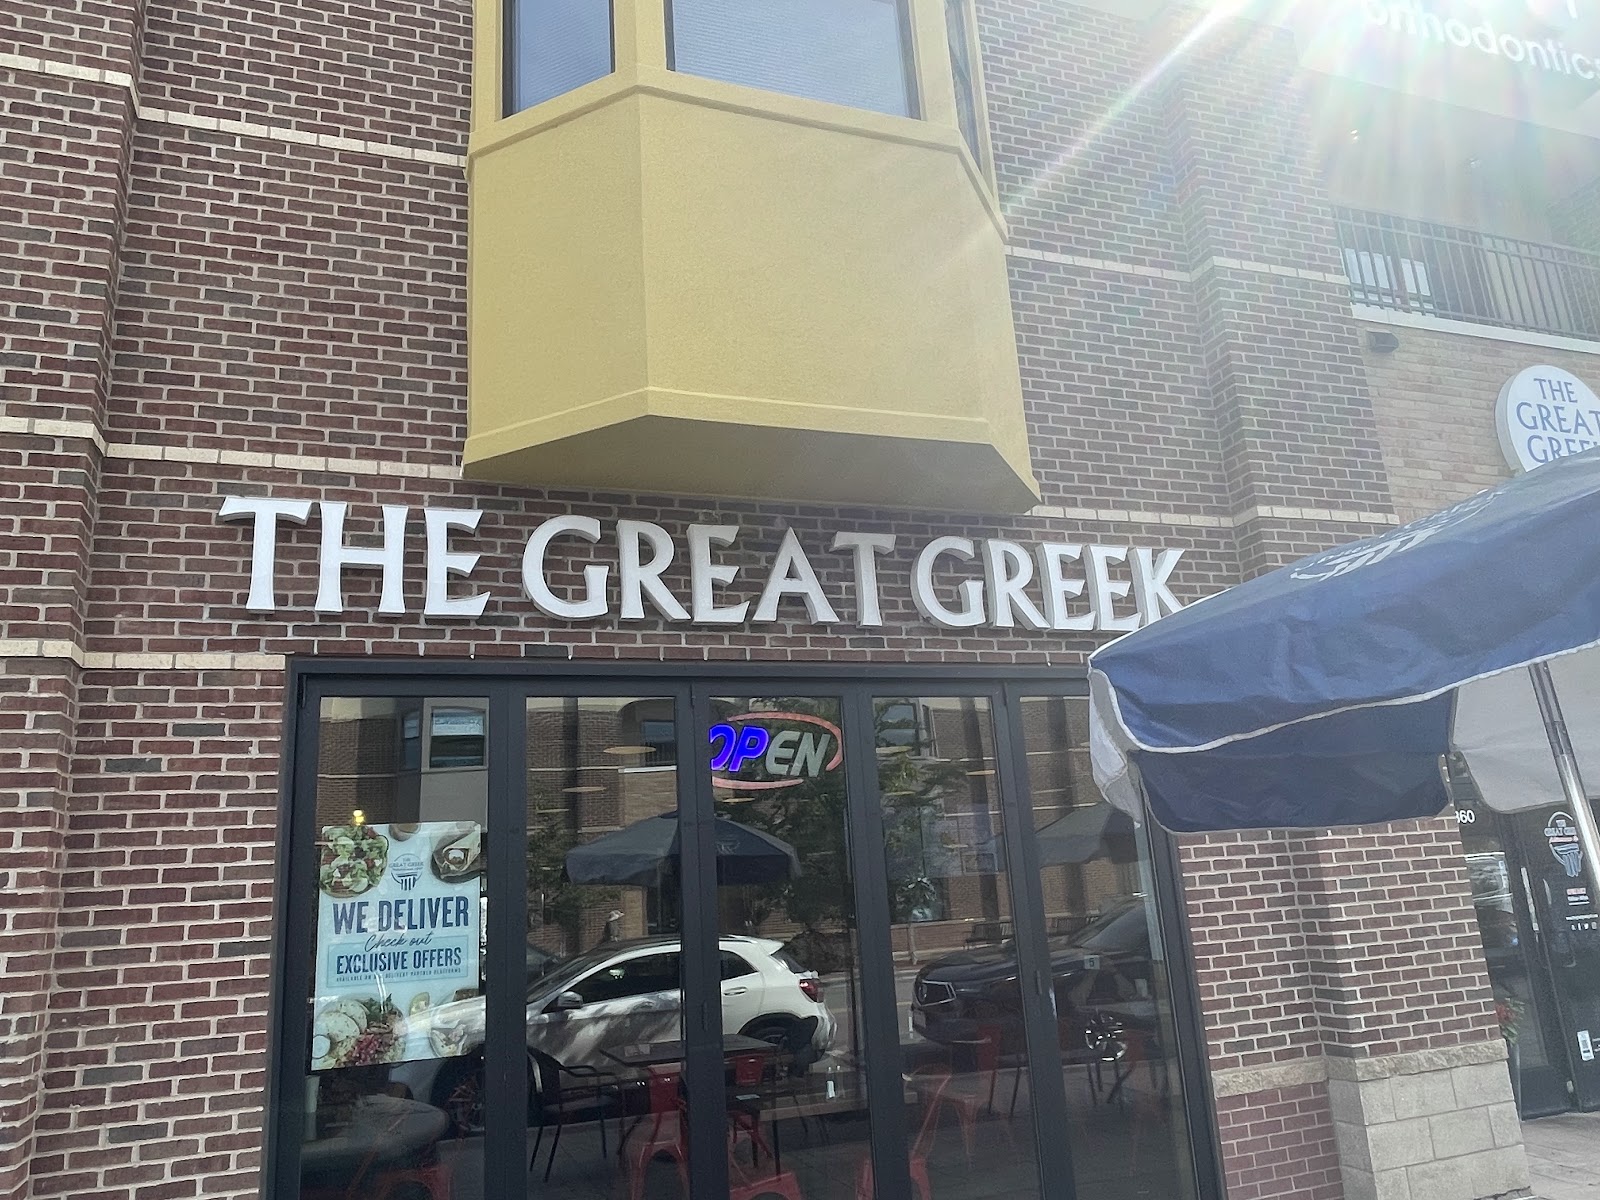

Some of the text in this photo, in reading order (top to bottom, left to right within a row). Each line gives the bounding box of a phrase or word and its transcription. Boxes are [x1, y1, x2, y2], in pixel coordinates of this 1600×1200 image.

[1533, 378, 1578, 403] THE
[1527, 434, 1597, 463] GRE
[218, 495, 1185, 631] THE GREAT GREEK
[709, 723, 830, 778] OPEN
[332, 895, 469, 935] WE DELIVER
[365, 931, 434, 953] Check out
[336, 947, 462, 975] EXCLUSIVE OFFERS
